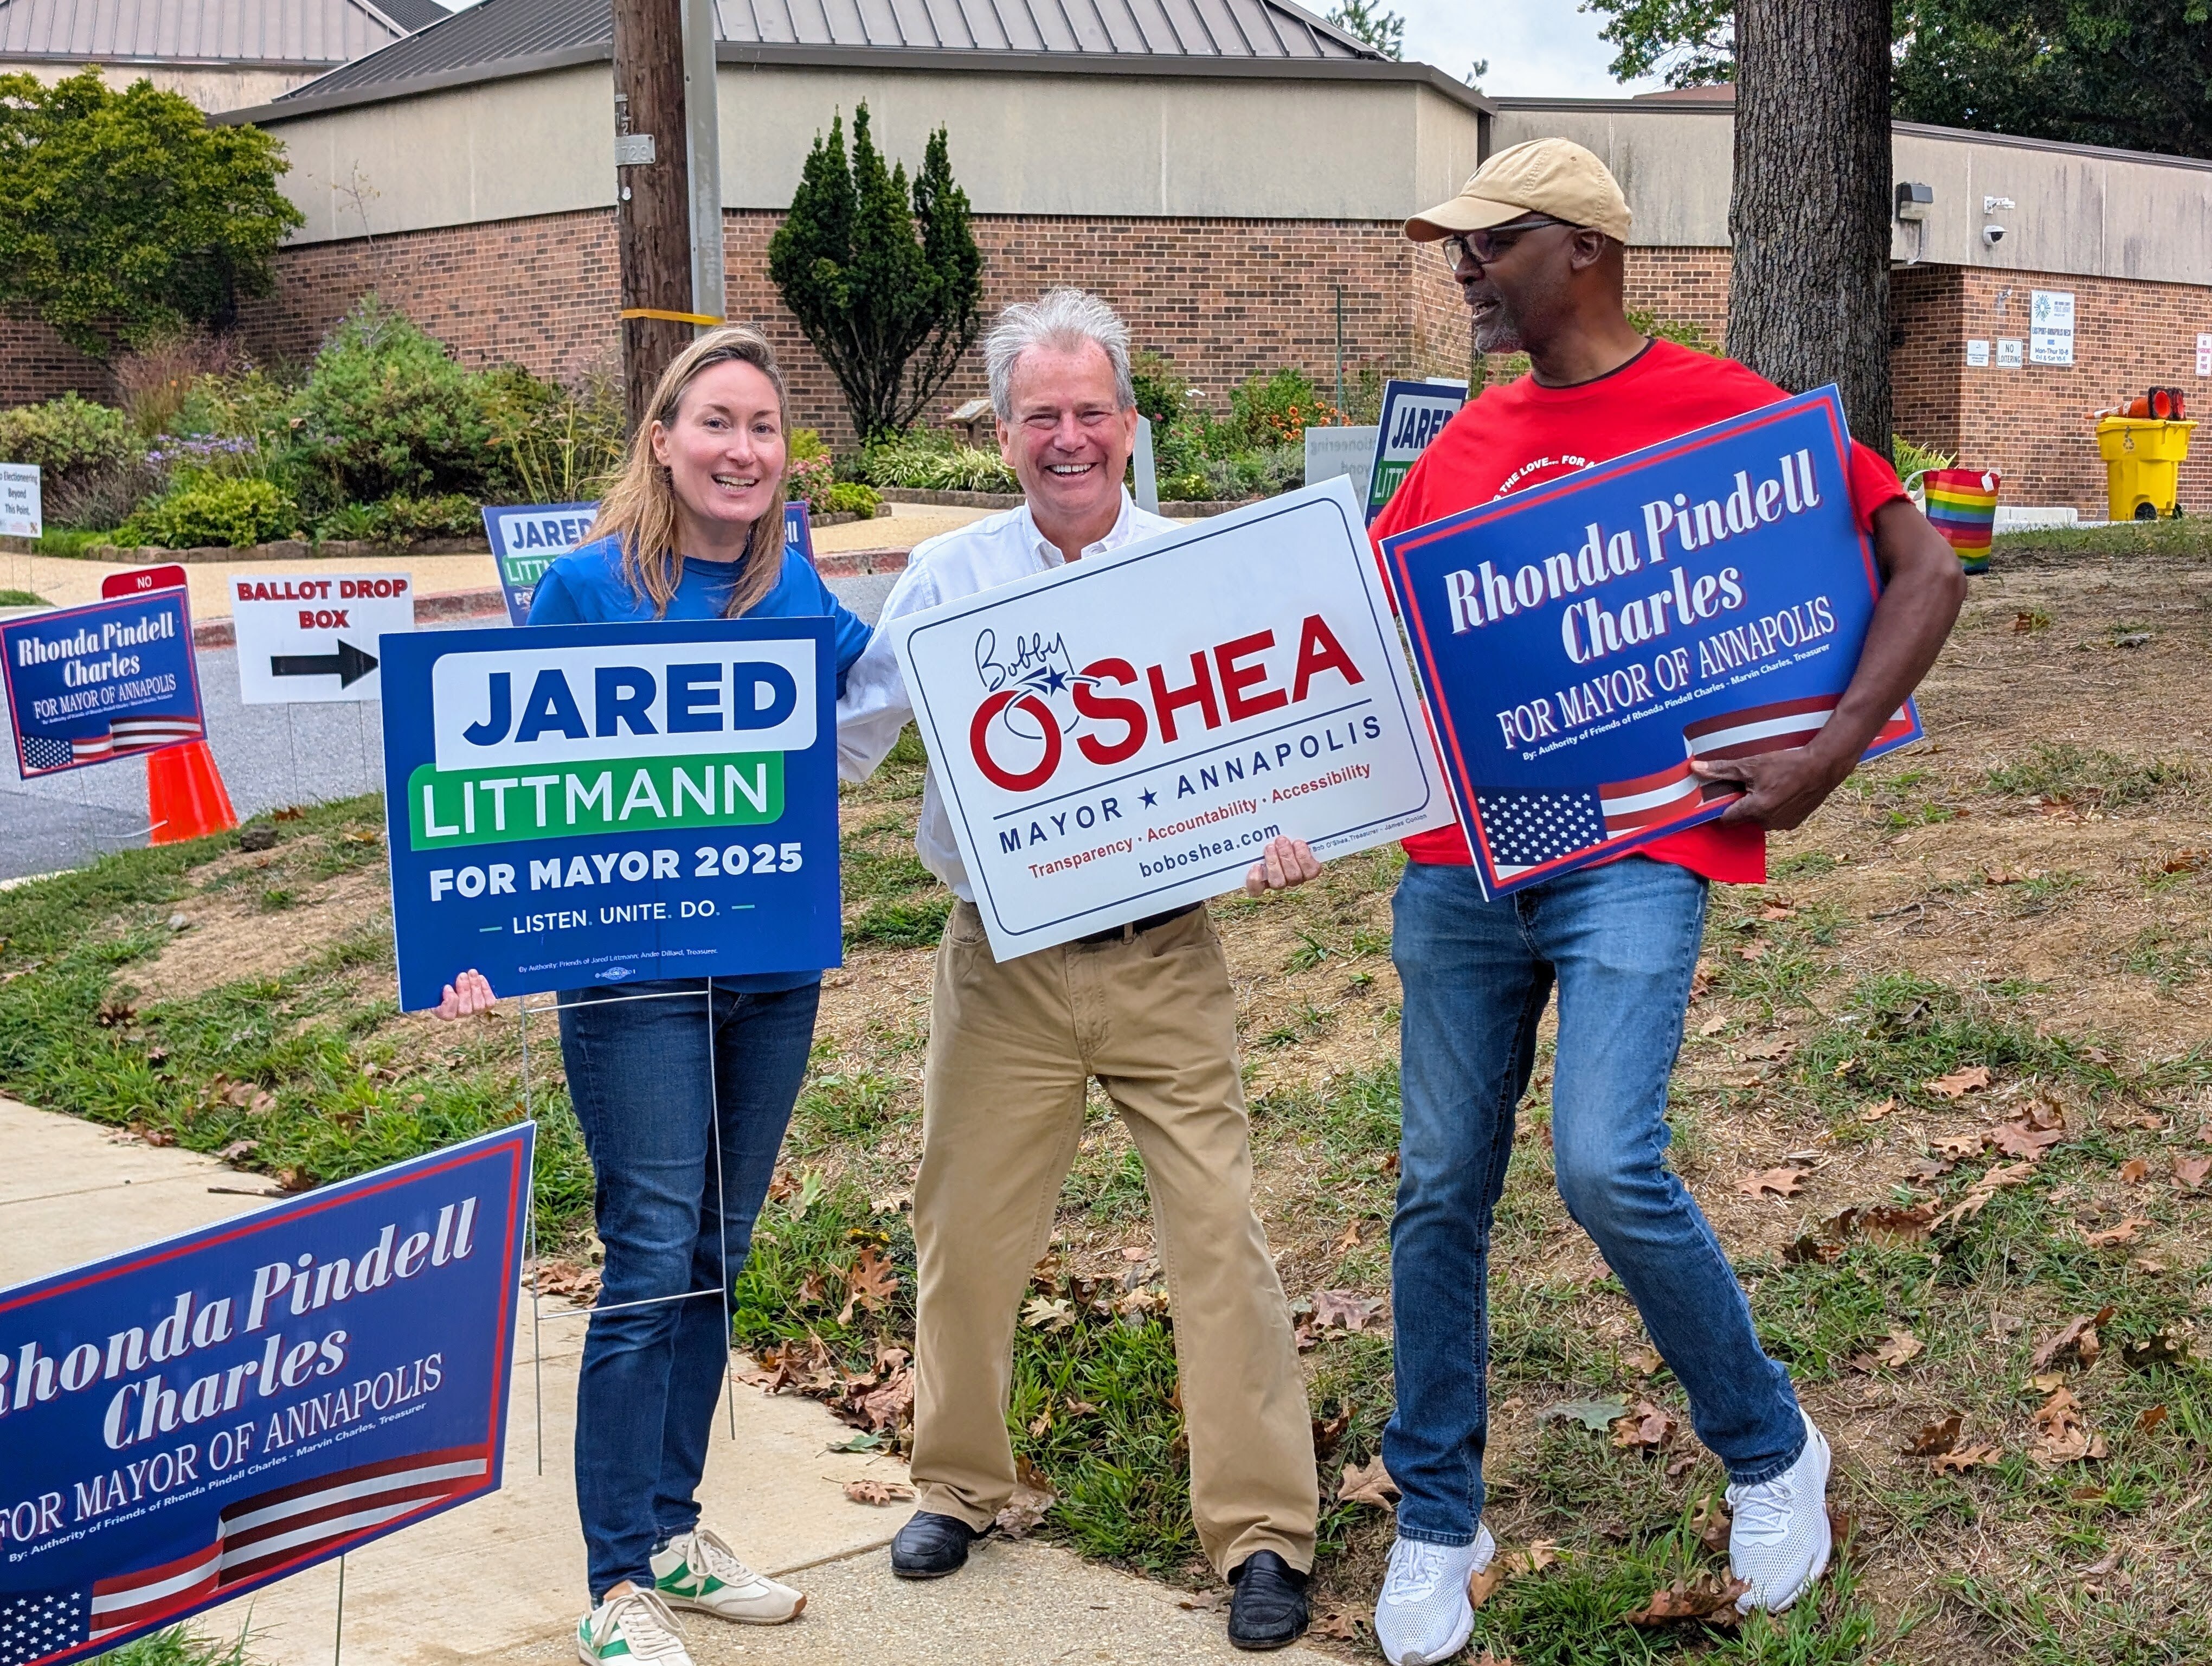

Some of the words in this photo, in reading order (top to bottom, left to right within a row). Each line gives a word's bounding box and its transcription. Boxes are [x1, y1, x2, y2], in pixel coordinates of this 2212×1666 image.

[2005, 344, 2014, 353] NO
[4, 471, 38, 485] Electioneering
[8, 487, 27, 499] Beyond
[1499, 472, 1520, 492] THE
[1561, 455, 1585, 466] FOR
[5, 503, 15, 514] This
[1443, 522, 1641, 635] Rhonda
[1641, 448, 1821, 565] Pindell
[137, 575, 152, 589] NO
[237, 581, 332, 601] BALLOT
[340, 579, 408, 599] DROP
[17, 628, 100, 667] Rhonda
[102, 611, 175, 650] Pindell
[299, 610, 351, 629] BOX
[1561, 566, 1744, 664] Charles
[63, 651, 140, 687] Charles
[975, 628, 1075, 692] Bobby
[1496, 699, 1558, 750] FOR
[1555, 662, 1654, 728] MAYOR
[1655, 647, 1688, 692] OF
[1699, 595, 1836, 678] ANNAPOLIS
[33, 698, 59, 719] FOR
[59, 689, 99, 714] MAYOR
[101, 685, 115, 705] OF
[119, 674, 176, 701] ANNAPOLIS
[462, 661, 798, 746] JARED
[1522, 751, 1537, 760] By:
[1538, 736, 1578, 754] Authority
[1579, 729, 1588, 740] of
[1590, 720, 1621, 735] Friends
[1622, 714, 1631, 725] of
[1632, 705, 1664, 720] Rhonda
[1664, 693, 1693, 709] Pindell
[1694, 683, 1725, 698] Charles
[1731, 670, 1759, 685] Marvin
[1760, 658, 1793, 674] Charles,
[1793, 644, 1830, 662] Treasurer
[422, 763, 767, 838] LITTMANN
[999, 797, 1123, 854] MAYOR
[1176, 715, 1381, 799] ANNAPOLIS
[1028, 837, 1134, 880] Transparency
[1147, 797, 1257, 843] Accountability
[1271, 762, 1372, 803] Accessibility
[429, 863, 516, 902] FOR
[530, 849, 680, 891] MAYOR
[694, 842, 802, 877] 2025
[1139, 823, 1281, 878] boboshea.com
[513, 909, 592, 934] LISTEN.
[600, 903, 672, 924] UNITE.
[680, 900, 720, 919] DO.
[560, 959, 582, 967] Friends
[0, 1291, 233, 1413] honda
[243, 1196, 477, 1332] Pindell
[103, 1330, 347, 1450] Charles
[74, 1444, 198, 1522] MAYOR
[209, 1421, 255, 1471] OF
[262, 1353, 442, 1453] ANNAPOLIS
[9, 1552, 28, 1562] By:
[30, 1529, 86, 1555] Authority
[89, 1522, 101, 1533] of
[104, 1508, 146, 1528] Friends
[149, 1501, 162, 1512] of
[163, 1486, 205, 1507] Rhonda
[208, 1469, 245, 1489] Pindell
[247, 1454, 287, 1475] Charles
[297, 1438, 332, 1457] Marvin
[335, 1423, 376, 1442] Charles,
[378, 1402, 427, 1425] Treasurer
